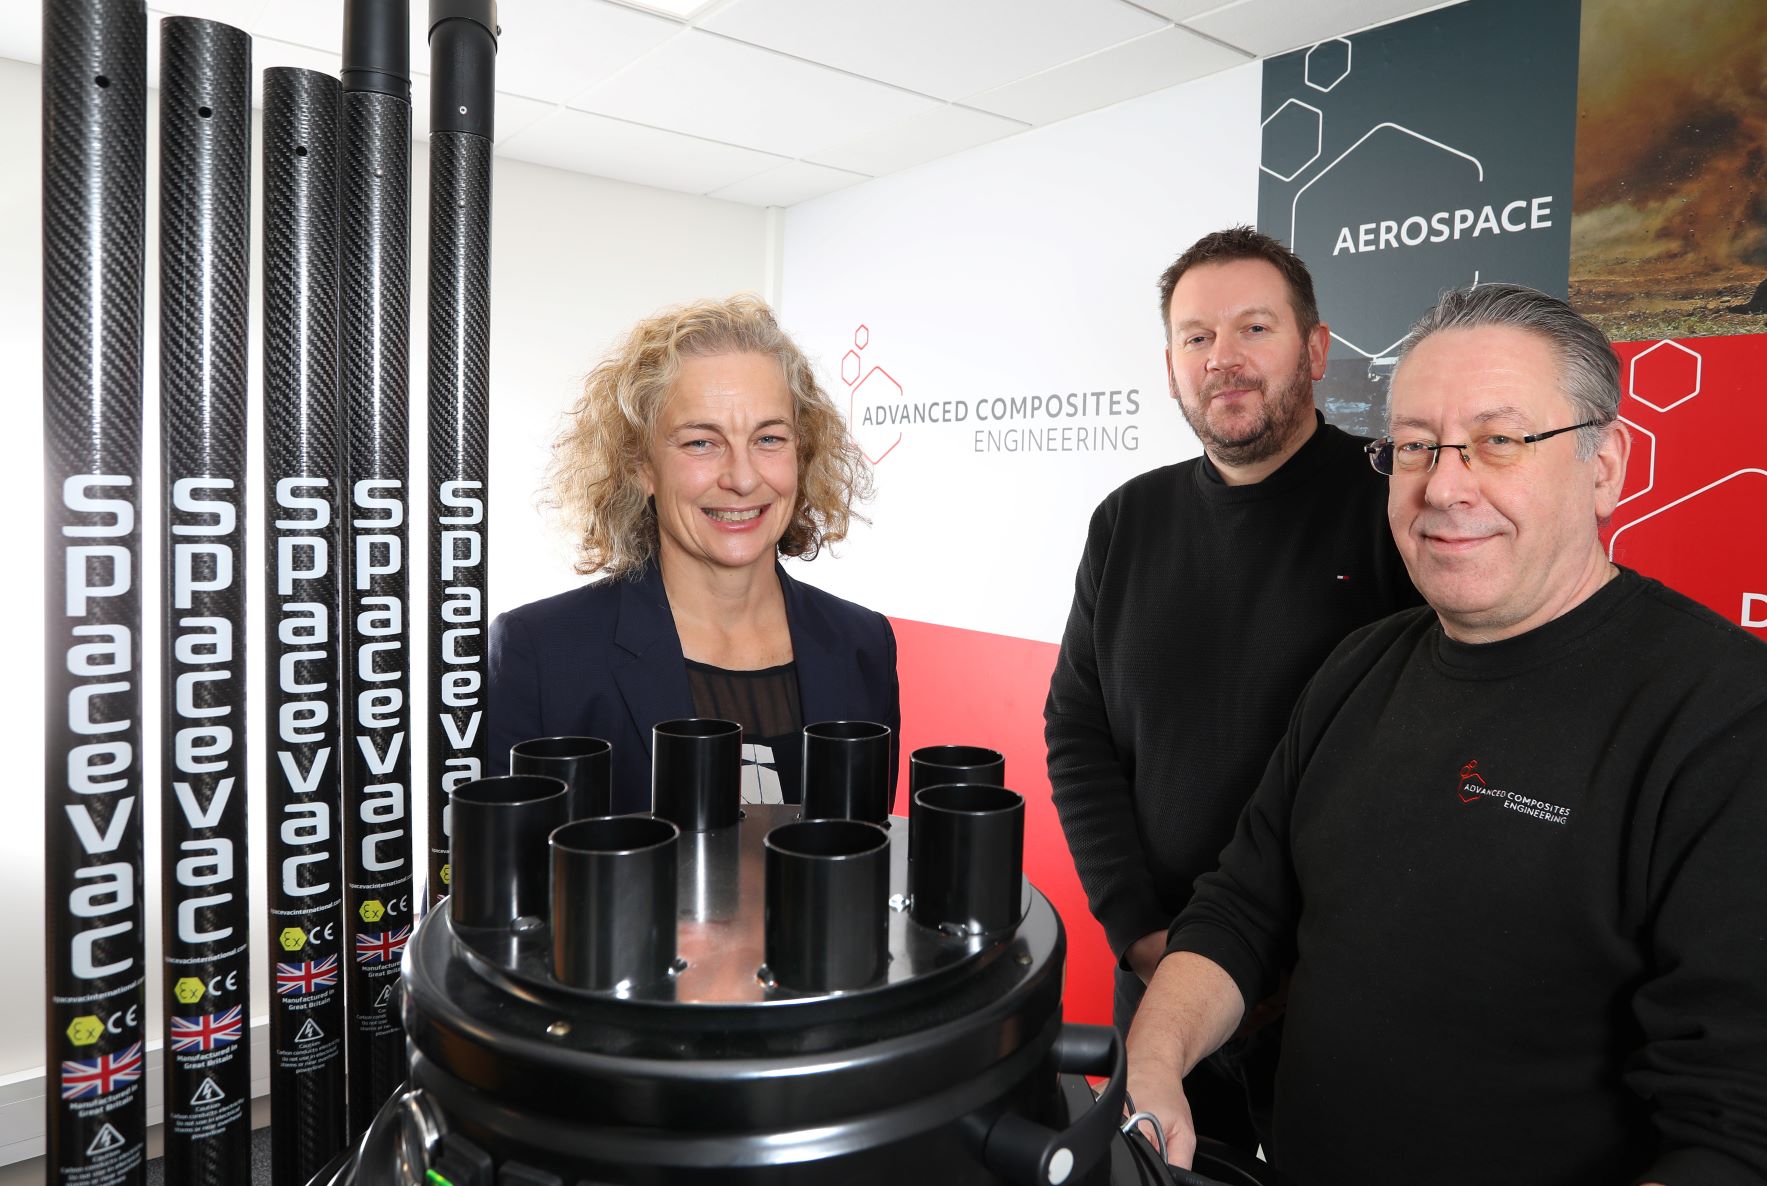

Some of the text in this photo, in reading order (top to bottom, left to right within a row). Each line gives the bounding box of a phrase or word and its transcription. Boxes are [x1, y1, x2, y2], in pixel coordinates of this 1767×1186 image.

[1332, 196, 1553, 256] AEROSPACE
[862, 389, 1141, 427] ADVANCED COMPOSITES
[974, 425, 1140, 453] ENGINEERING
[438, 480, 484, 837] Spaceva
[1464, 784, 1570, 816] ADVANCED COMPOSITES
[1503, 800, 1567, 825] ENGINEERING
[362, 961, 401, 971] Manufacture
[282, 992, 328, 1003] Manufactured
[309, 997, 331, 1009] Britain
[176, 1049, 230, 1061] Manufactured
[207, 1053, 233, 1067] Britain
